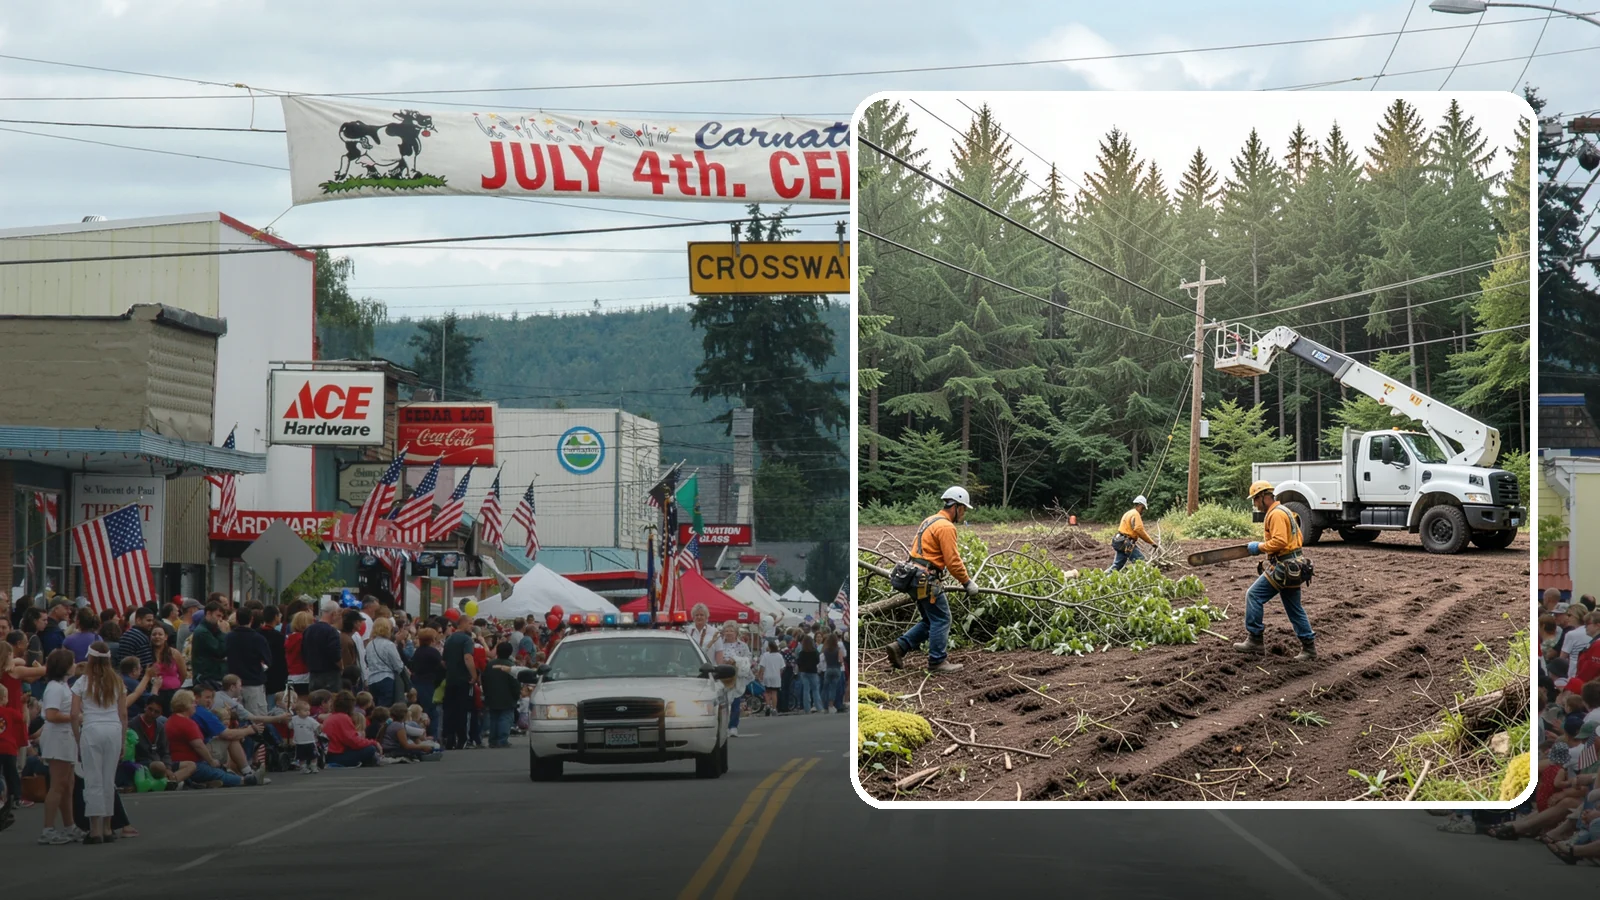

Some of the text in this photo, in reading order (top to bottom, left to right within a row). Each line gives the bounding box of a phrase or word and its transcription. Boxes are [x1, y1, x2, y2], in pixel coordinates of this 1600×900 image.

[481, 141, 604, 192] JULY
[632, 150, 747, 198] 4th.
[697, 254, 850, 280] CROSSWA
[282, 380, 373, 420] ACE
[405, 409, 452, 421] CEDAR
[283, 421, 370, 437] Hardware
[416, 428, 476, 447] Coca-Cola
[96, 485, 124, 495] Vincent
[126, 486, 136, 495] de
[138, 486, 155, 496] Paul
[688, 526, 741, 535] CRNATION
[699, 535, 730, 543] GLASS
